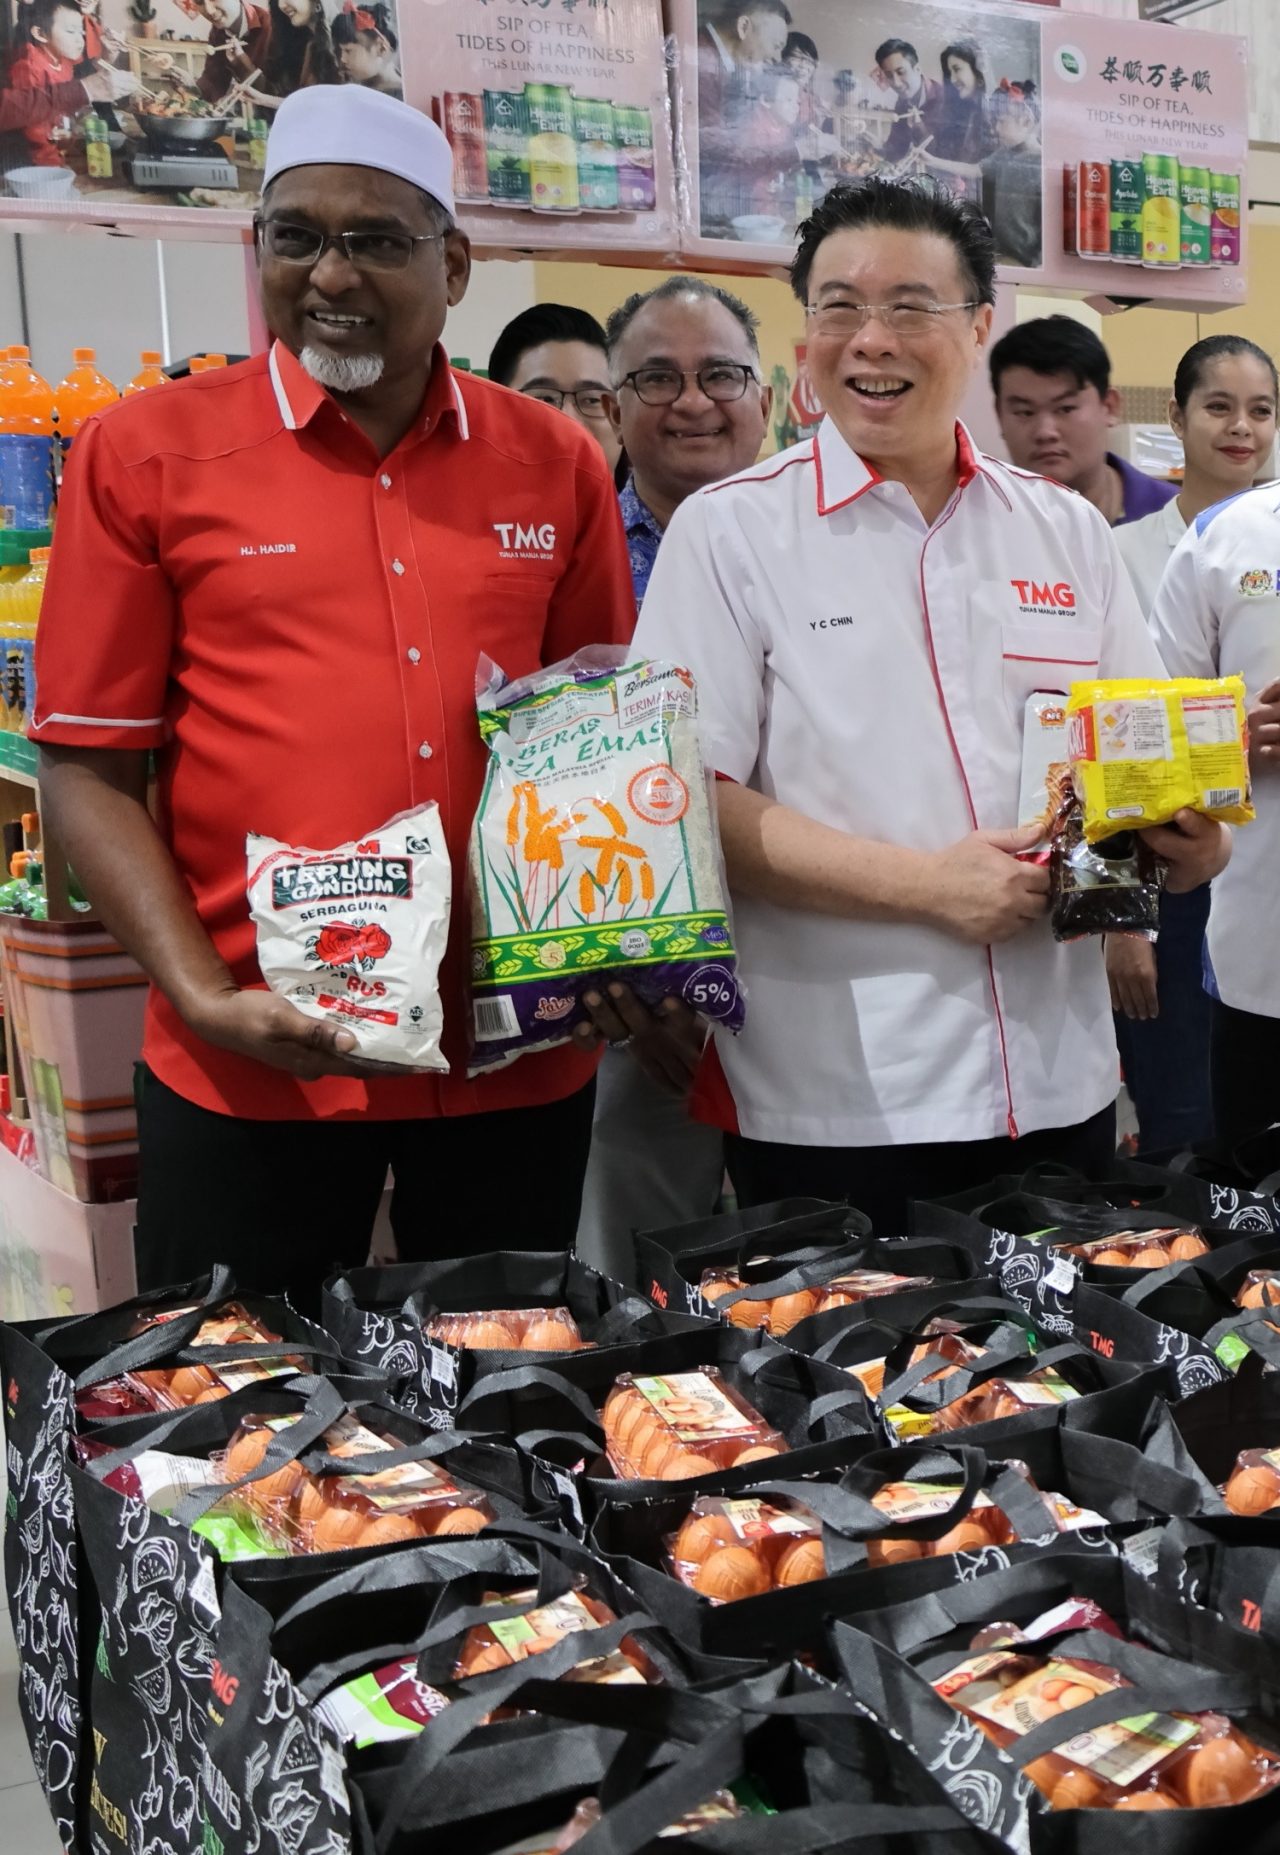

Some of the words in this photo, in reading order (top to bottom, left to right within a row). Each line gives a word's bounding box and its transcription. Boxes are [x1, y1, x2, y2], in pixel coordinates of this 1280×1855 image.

[497, 16, 523, 31] SIP
[528, 19, 551, 34] OF
[456, 34, 505, 51] TIDES
[510, 38, 534, 53] OF
[540, 41, 635, 64] HAPPINESS
[481, 57, 507, 70] THIS
[510, 60, 551, 73] LUNAR
[555, 64, 583, 75] NEW
[583, 66, 616, 80] YEAR
[1118, 93, 1140, 107] SIP
[1143, 98, 1161, 110] OF
[1086, 108, 1125, 125] TIDES
[1128, 114, 1147, 127] OF
[1151, 117, 1225, 138] HAPPINESS
[1104, 128, 1124, 141] THIS
[493, 522, 556, 550] TMG
[259, 543, 297, 555] HAIDIR
[1010, 579, 1076, 608] TMG
[810, 621, 817, 631] Y
[820, 619, 828, 629] C
[830, 616, 854, 627] CHIN
[1019, 606, 1037, 614] TUNAS
[1058, 610, 1077, 618] GROUP
[623, 695, 662, 718] TERIMA
[518, 718, 601, 760] BERAS
[577, 718, 669, 763] EMAS
[291, 877, 394, 901] GANDUM
[692, 981, 731, 1005] 5%
[409, 1006, 424, 1016] MS
[651, 1280, 668, 1309] TMG
[1090, 1331, 1114, 1359] TMG
